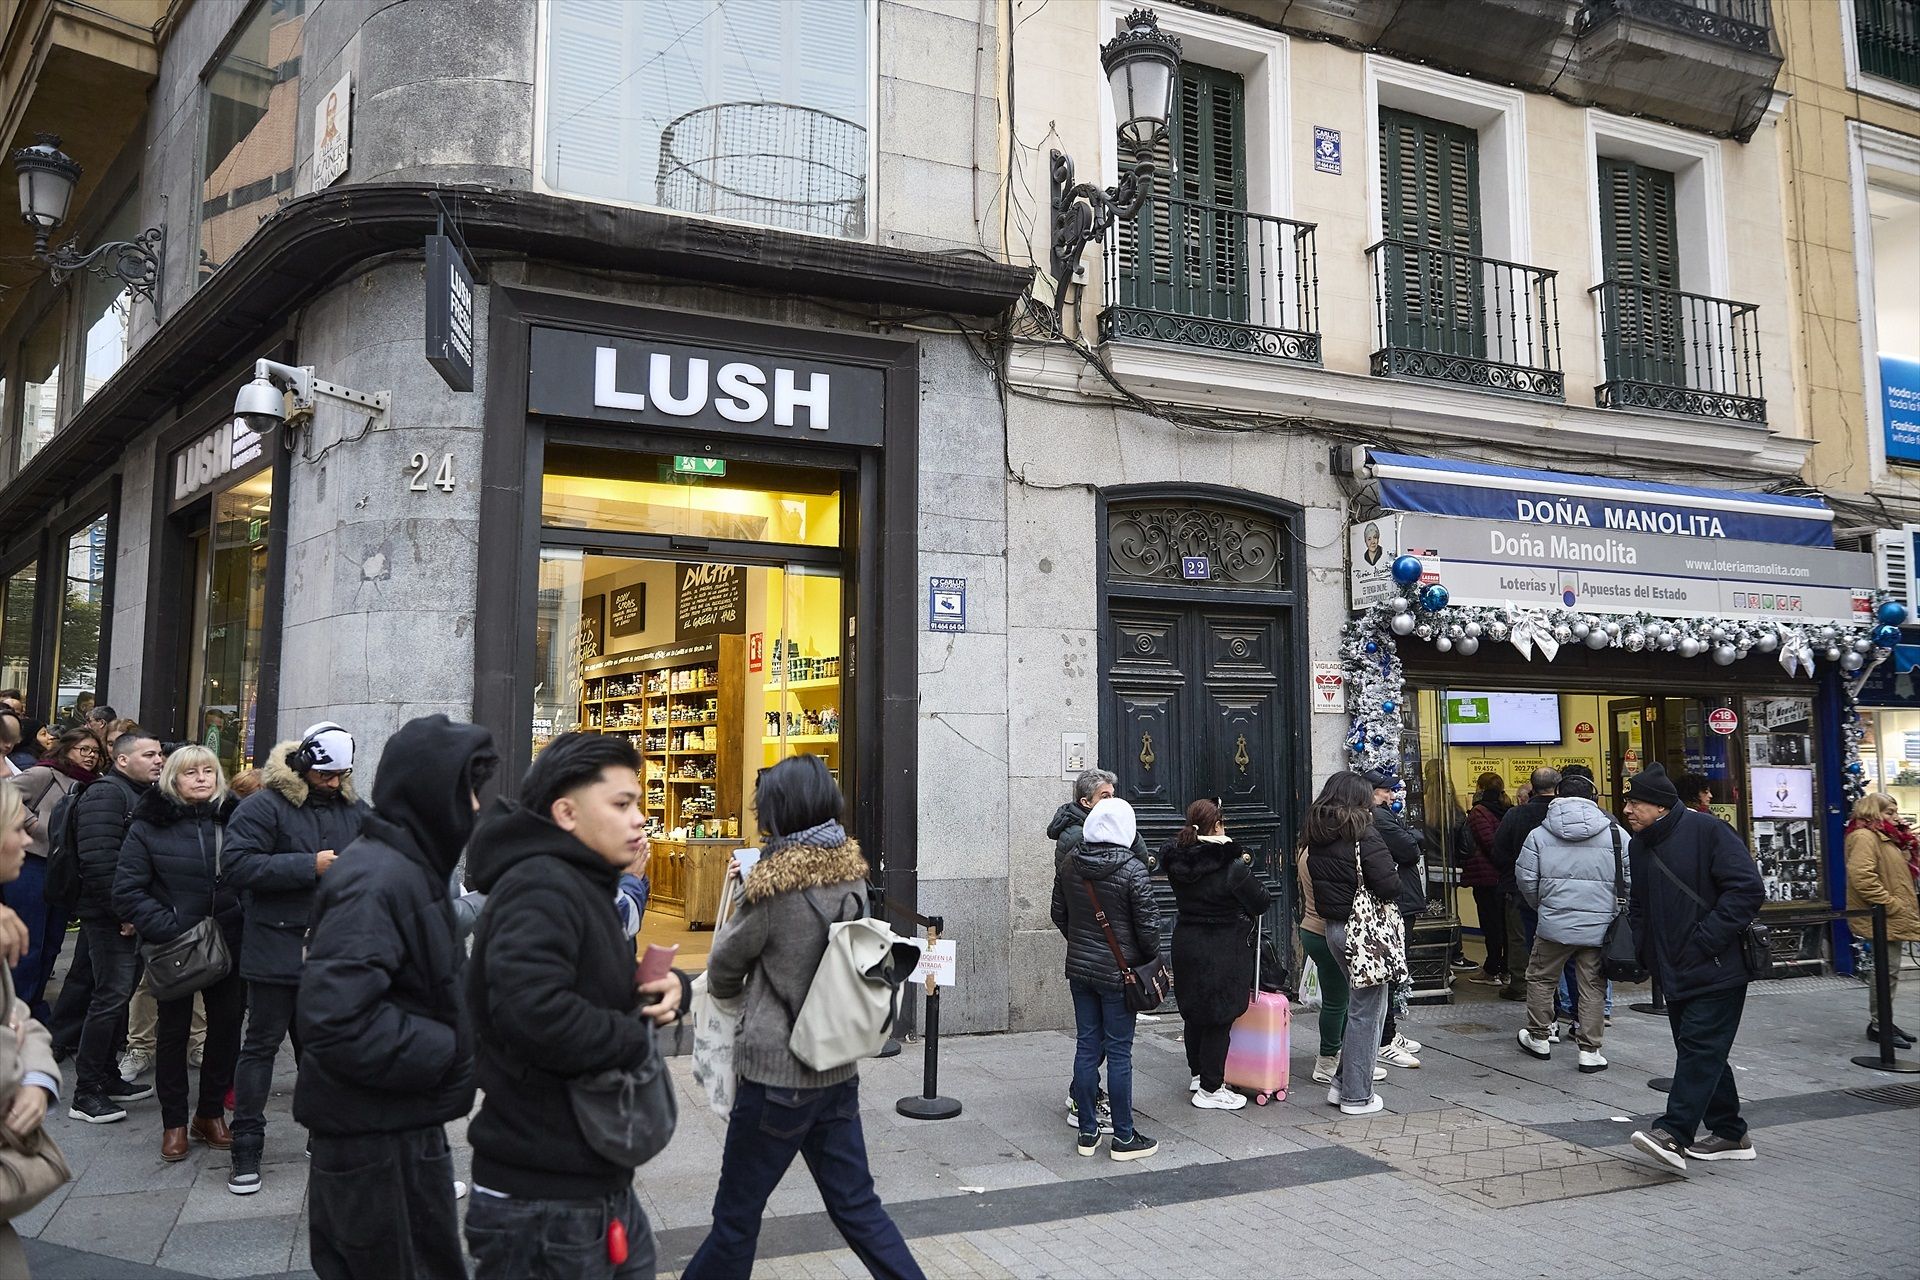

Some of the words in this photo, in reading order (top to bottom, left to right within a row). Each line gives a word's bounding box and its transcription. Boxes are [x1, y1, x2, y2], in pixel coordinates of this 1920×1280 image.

[450, 263, 472, 316] LUSH
[450, 291, 472, 339] FRESH
[594, 346, 830, 430] LUSH
[1887, 386, 1911, 399] Moda
[1892, 433, 1915, 445] whole
[174, 423, 233, 500] LUSH
[410, 452, 456, 491] 24
[1516, 497, 1591, 527] DOÑA
[1604, 508, 1726, 538] MANOLITA
[1490, 530, 1545, 558] Doña
[1550, 535, 1637, 565] Manolita
[682, 564, 735, 591] DUCHA
[1187, 561, 1205, 574] 22
[1685, 559, 1810, 578] www.loteriamanolita.com
[1500, 577, 1546, 592] Loterías
[1548, 581, 1556, 595] y
[1581, 582, 1631, 598] Apuestas
[1634, 584, 1650, 599] del
[1652, 586, 1687, 601] Estado
[692, 612, 718, 628] GREEN
[720, 609, 737, 623] HUB
[1714, 711, 1731, 720] +18
